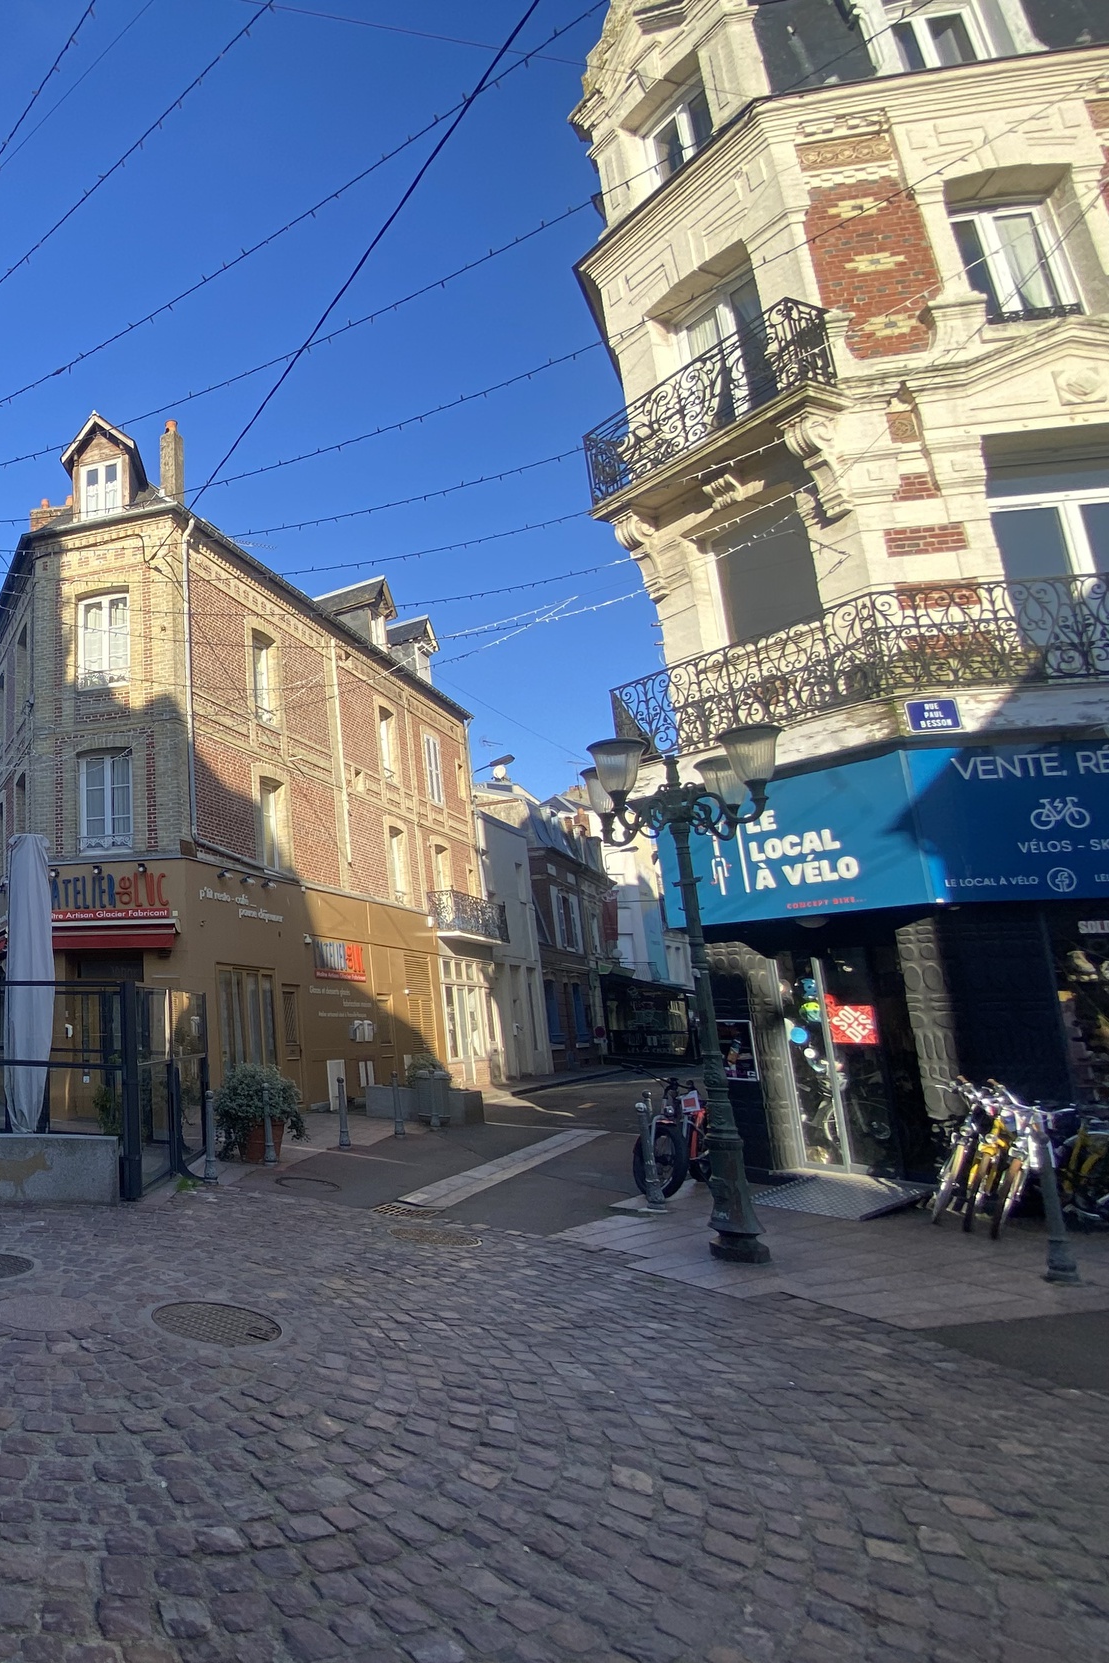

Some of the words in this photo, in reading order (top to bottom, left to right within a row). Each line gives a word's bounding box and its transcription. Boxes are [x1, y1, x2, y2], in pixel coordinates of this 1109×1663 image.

[924, 702, 940, 711] RUE
[923, 711, 945, 719] PAUL
[919, 719, 953, 728] BESSON
[744, 809, 777, 834] LE
[748, 829, 841, 862] LOCAL
[1017, 838, 1073, 853] VÉLOS
[755, 862, 777, 890] À
[781, 854, 860, 886] VÉLO
[945, 878, 957, 888] LE
[959, 877, 998, 887] LOCAL
[999, 875, 1008, 885] À
[1010, 875, 1039, 885] VÉLO
[133, 872, 170, 907] LUC
[786, 898, 830, 910] CONCEPT
[65, 911, 94, 919] Artisan
[96, 909, 126, 918] Glacier
[128, 908, 168, 918] Fabricant
[832, 1005, 861, 1031] SOL
[845, 1014, 875, 1043] DES
